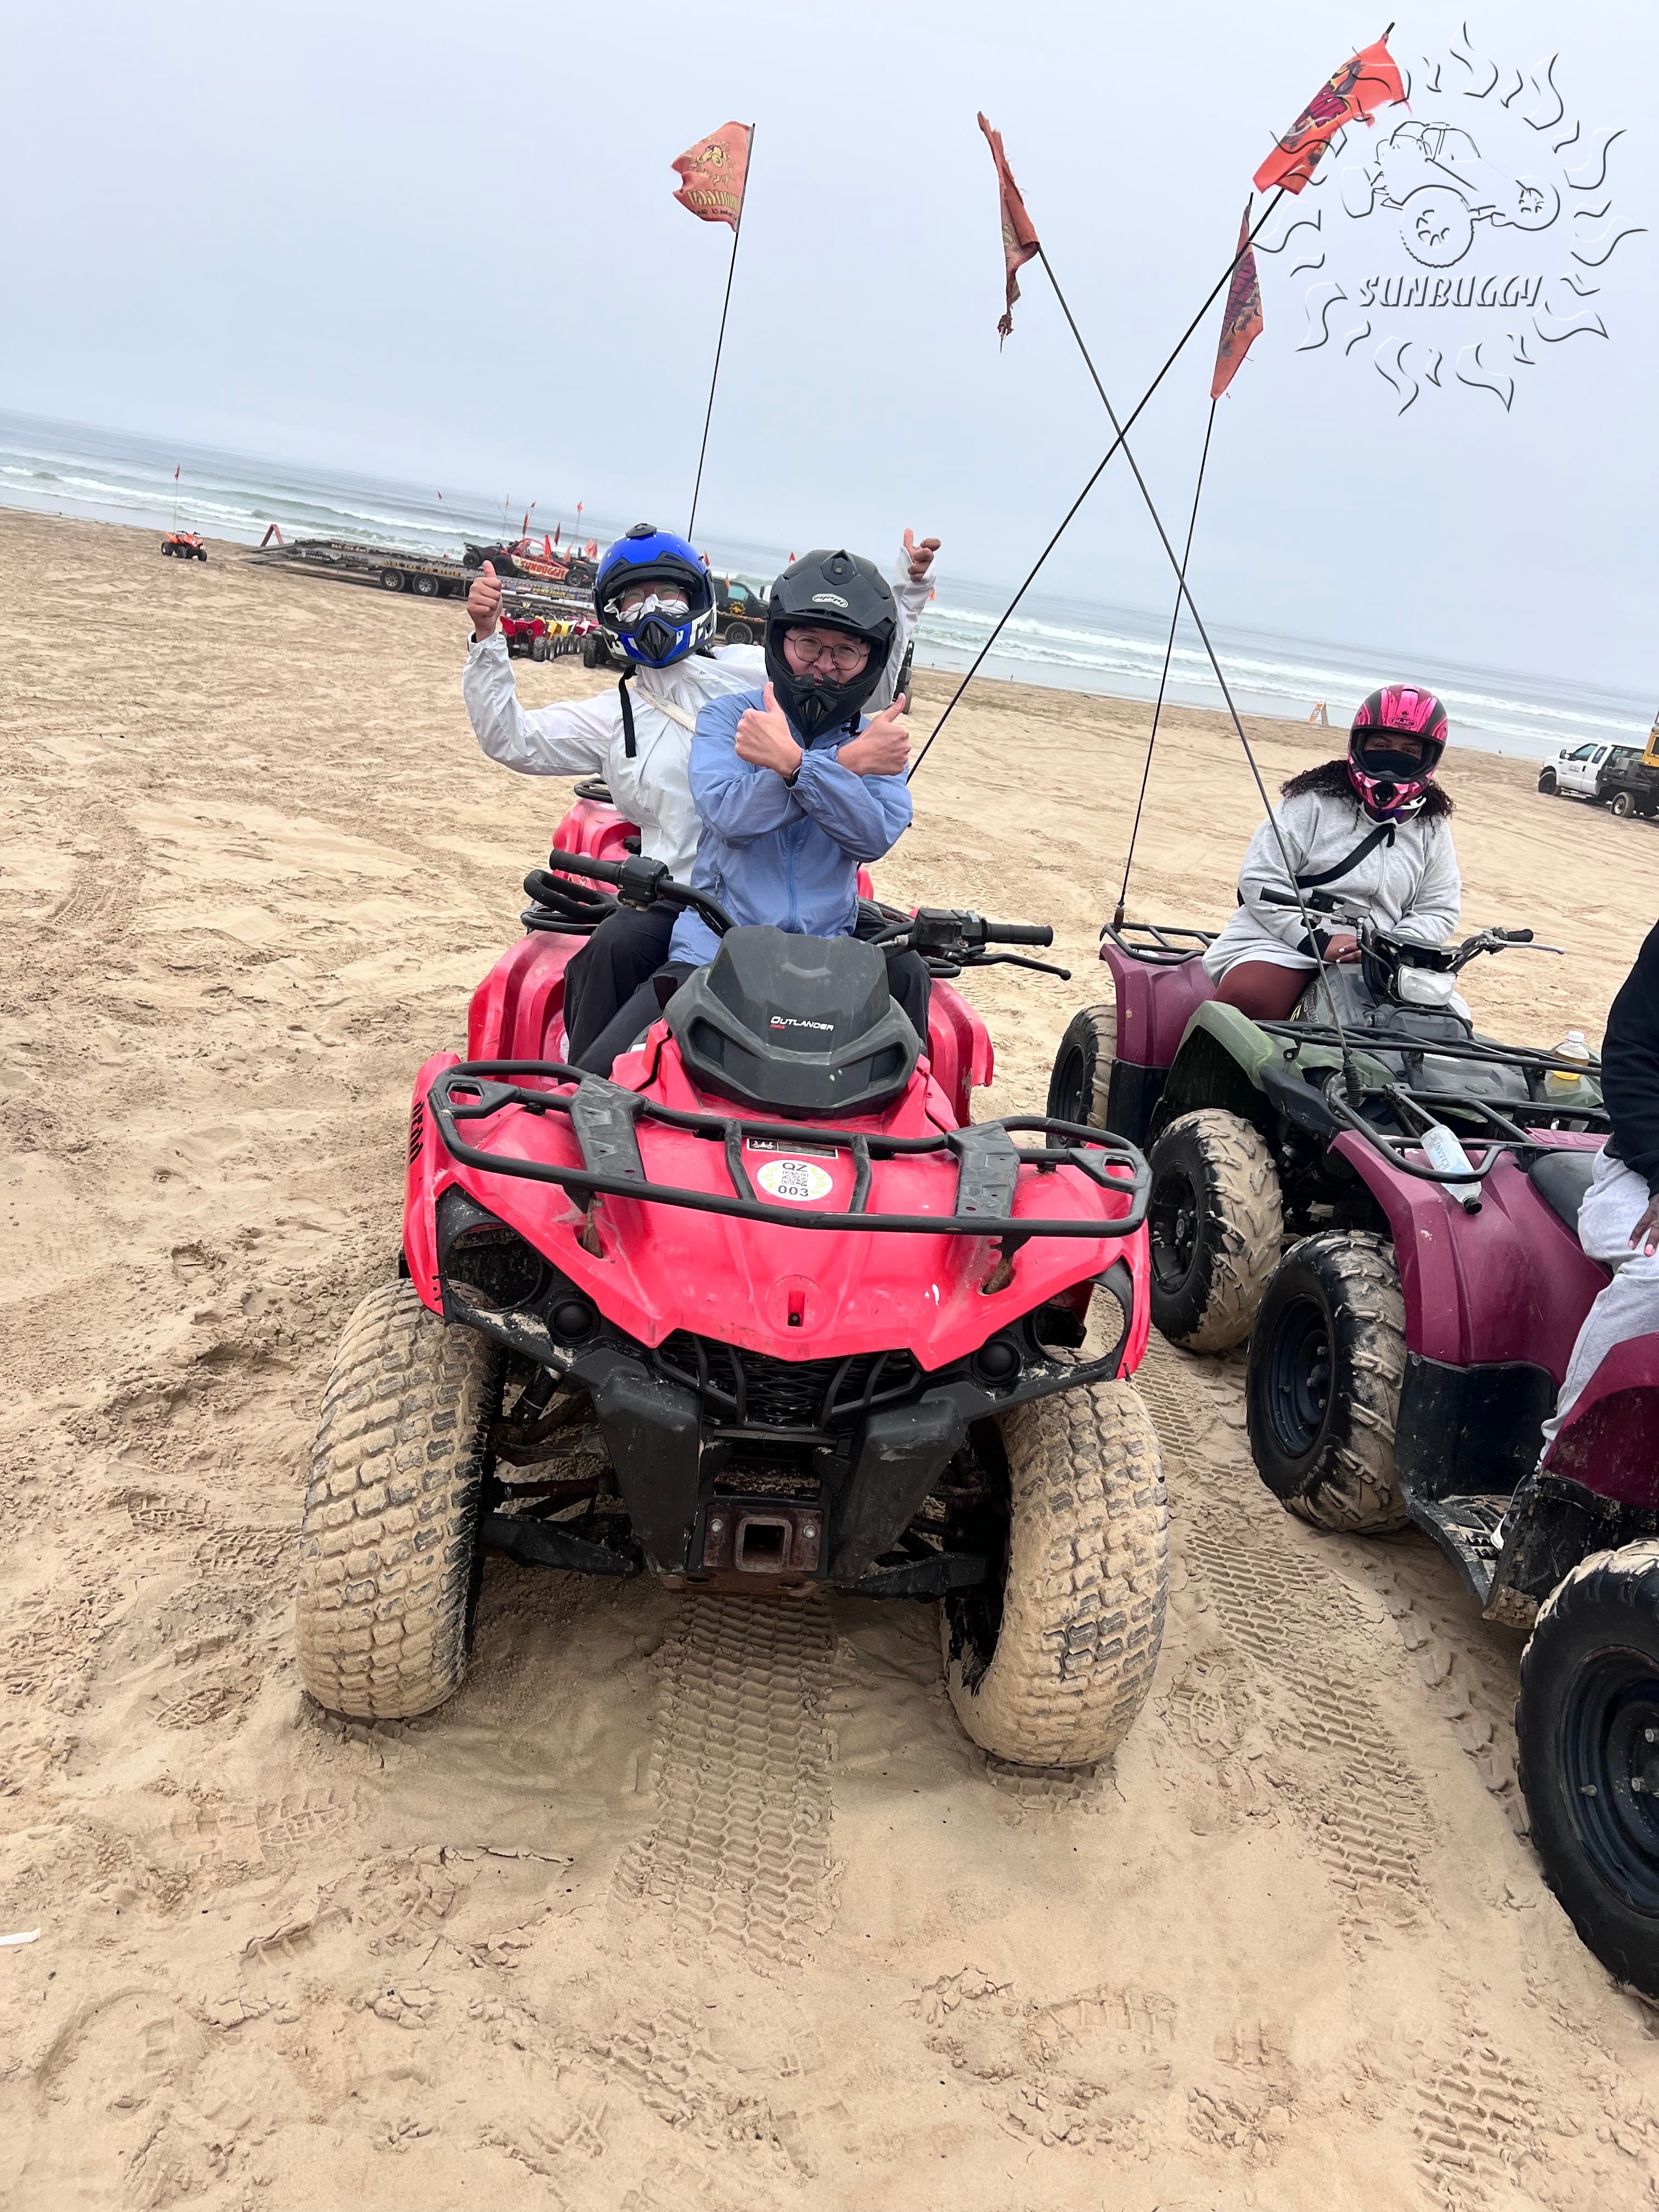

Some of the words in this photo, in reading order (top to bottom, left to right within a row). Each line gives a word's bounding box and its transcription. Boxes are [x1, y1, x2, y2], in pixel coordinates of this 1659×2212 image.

[521, 561, 566, 578] SUNBUGGIE
[770, 1016, 834, 1031] OUTLANDER
[1430, 1133, 1451, 1170] ICELANDIC
[782, 1163, 808, 1172] QZ
[778, 1185, 809, 1197] 003
